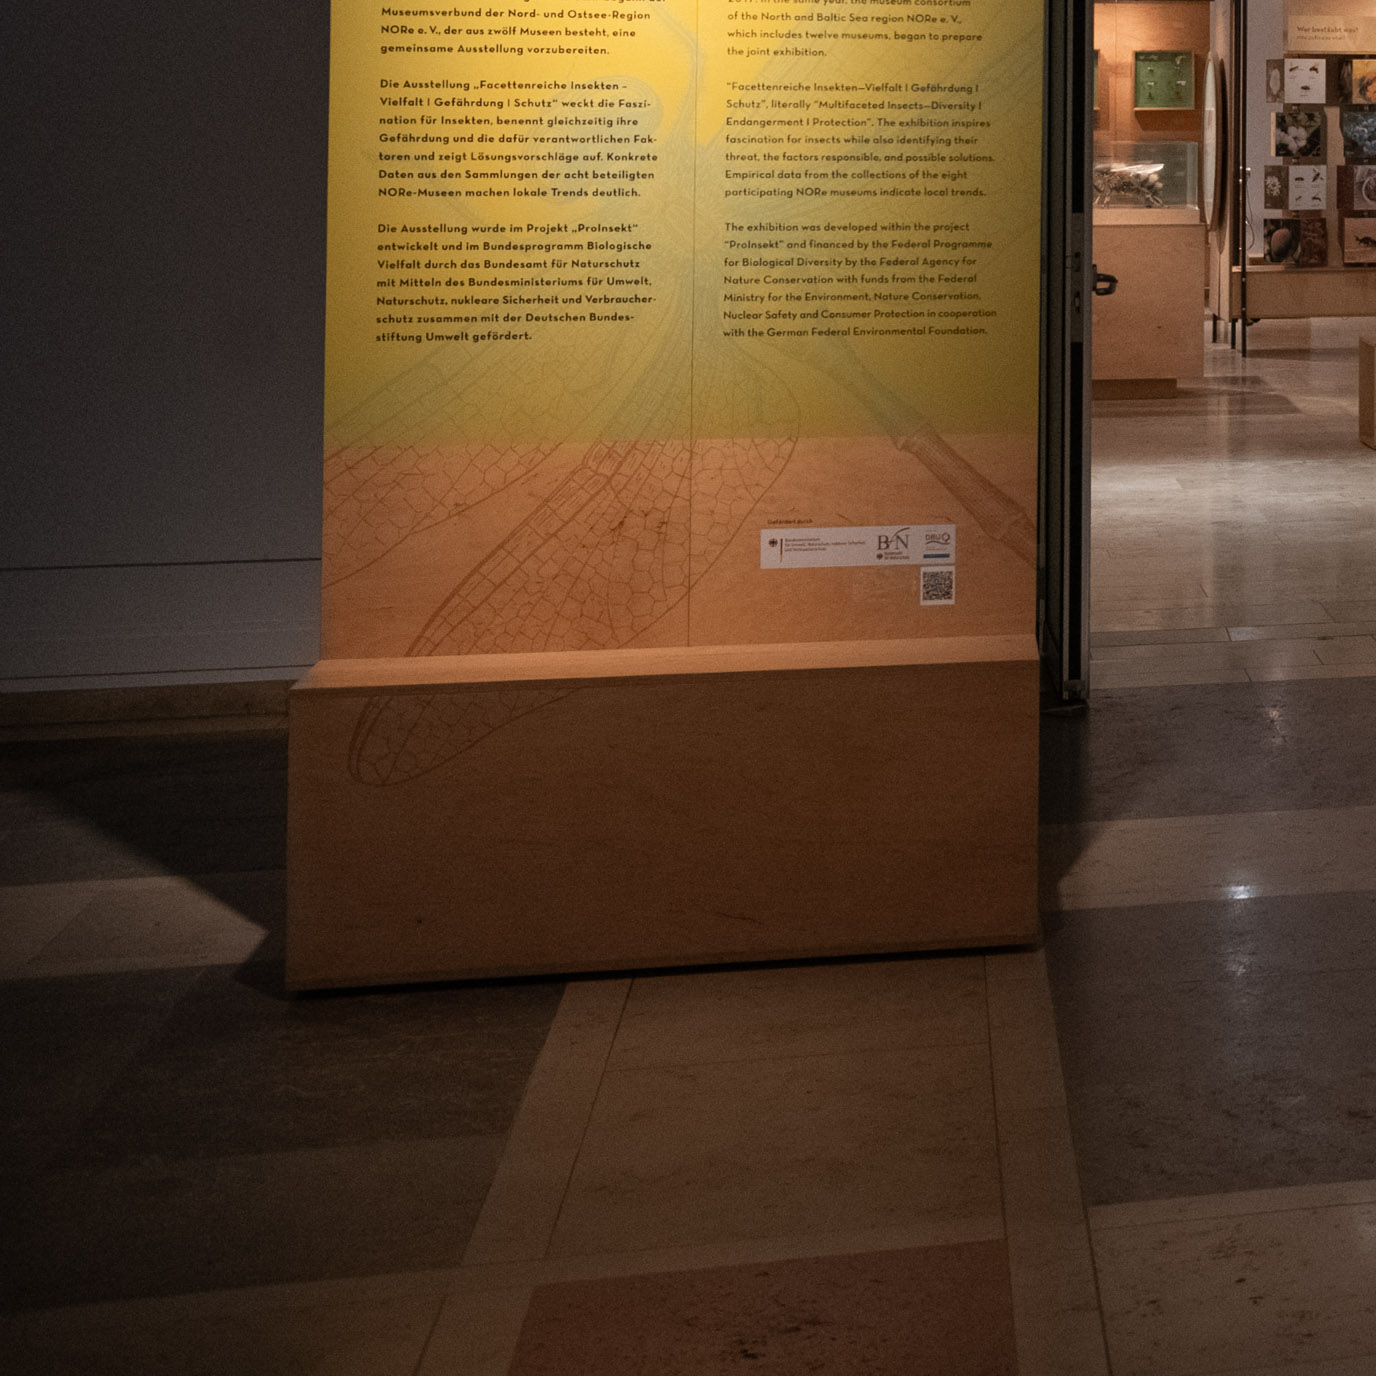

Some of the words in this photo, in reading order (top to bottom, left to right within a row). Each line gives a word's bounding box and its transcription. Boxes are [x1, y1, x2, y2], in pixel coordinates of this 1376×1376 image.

[377, 222, 398, 234] Die
[400, 222, 468, 237] Ausstellung
[471, 223, 507, 234] wurde
[509, 223, 524, 234] im
[526, 222, 569, 236] Projekt
[376, 240, 439, 252] entwickelt
[441, 240, 463, 252] und
[465, 241, 480, 252] im
[482, 240, 584, 254] Bundesprogramm
[586, 240, 653, 254] Biologische
[376, 258, 422, 270] Vielfalt
[423, 258, 458, 270] durch
[459, 258, 481, 270] das
[483, 258, 548, 270] Bundesamt
[550, 258, 569, 270] für
[570, 258, 641, 270] Naturschutz
[376, 277, 397, 288] mit
[398, 276, 442, 288] Mitteln
[444, 276, 466, 288] des
[467, 276, 584, 288] Bundesministeriums
[586, 275, 604, 287] für
[606, 275, 653, 288] Umwelt,
[376, 294, 449, 306] Naturschutz,
[450, 294, 500, 306] nukleare
[501, 294, 560, 306] Sicherheit
[561, 293, 583, 305] und
[584, 293, 657, 304] Verbraucher-
[375, 312, 414, 324] schutz
[416, 315, 478, 324] zusammen
[480, 313, 500, 324] mit
[502, 312, 523, 324] der
[525, 311, 587, 323] Deutschen
[588, 311, 635, 322] Bundes-
[375, 330, 422, 345] stiftung
[425, 330, 469, 342] Umwelt
[472, 330, 532, 344] gefördert.
